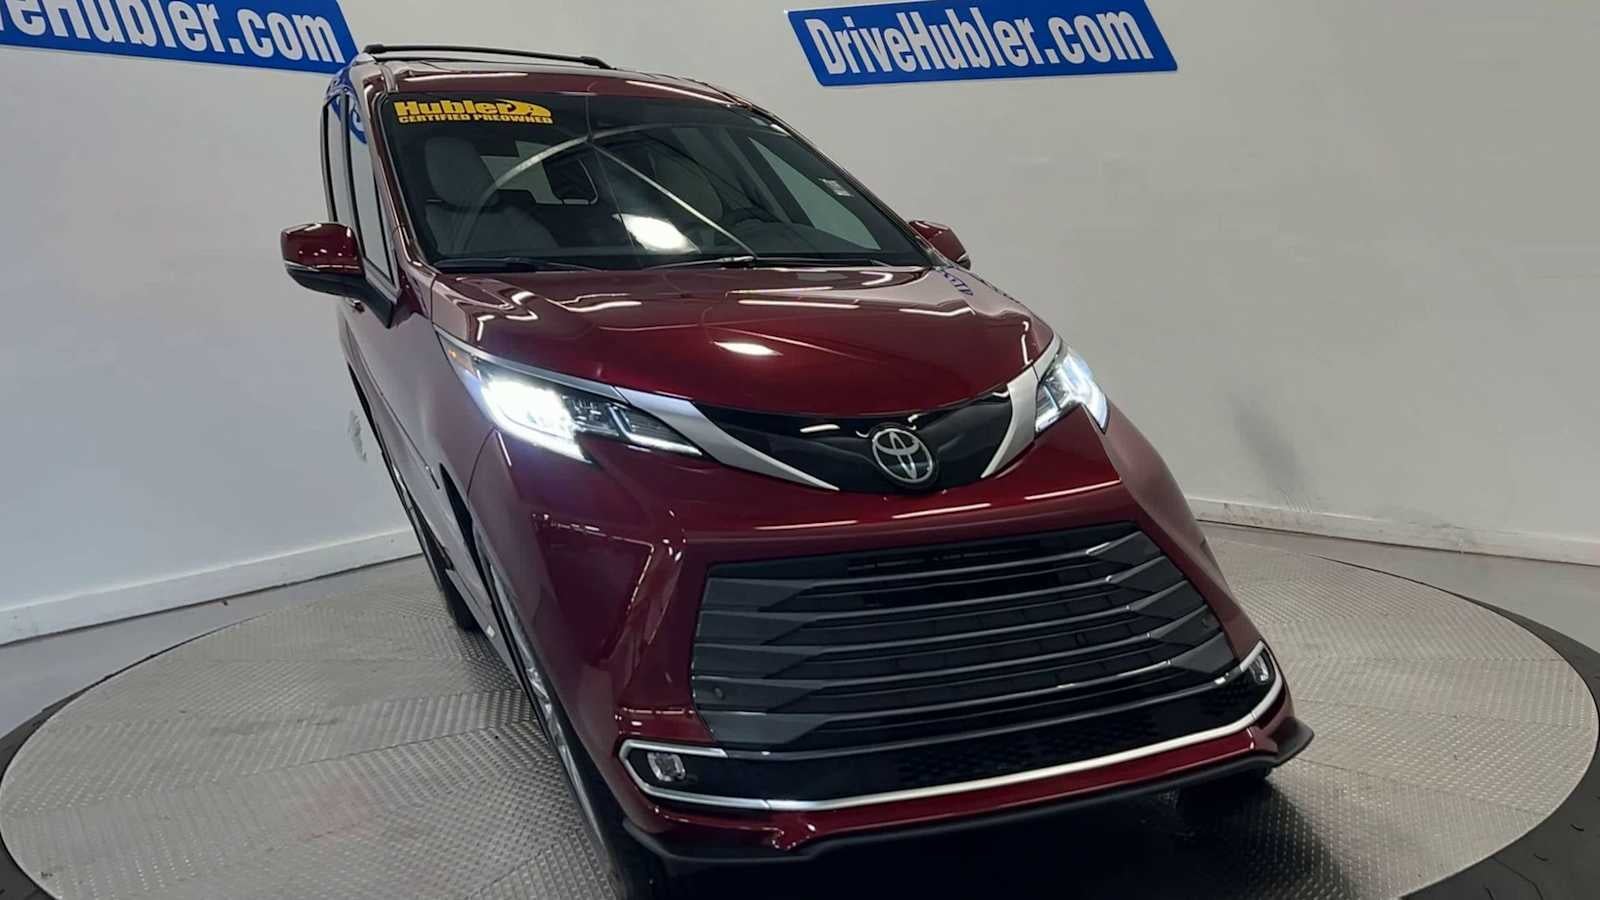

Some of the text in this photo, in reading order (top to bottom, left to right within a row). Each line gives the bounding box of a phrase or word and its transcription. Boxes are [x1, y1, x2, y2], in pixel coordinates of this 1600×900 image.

[0, 0, 345, 64] eHubler.com
[804, 7, 1154, 75] DriveHubler.com
[393, 99, 514, 116] Hubler
[398, 113, 553, 124] CERTIFIED PREOWNED
